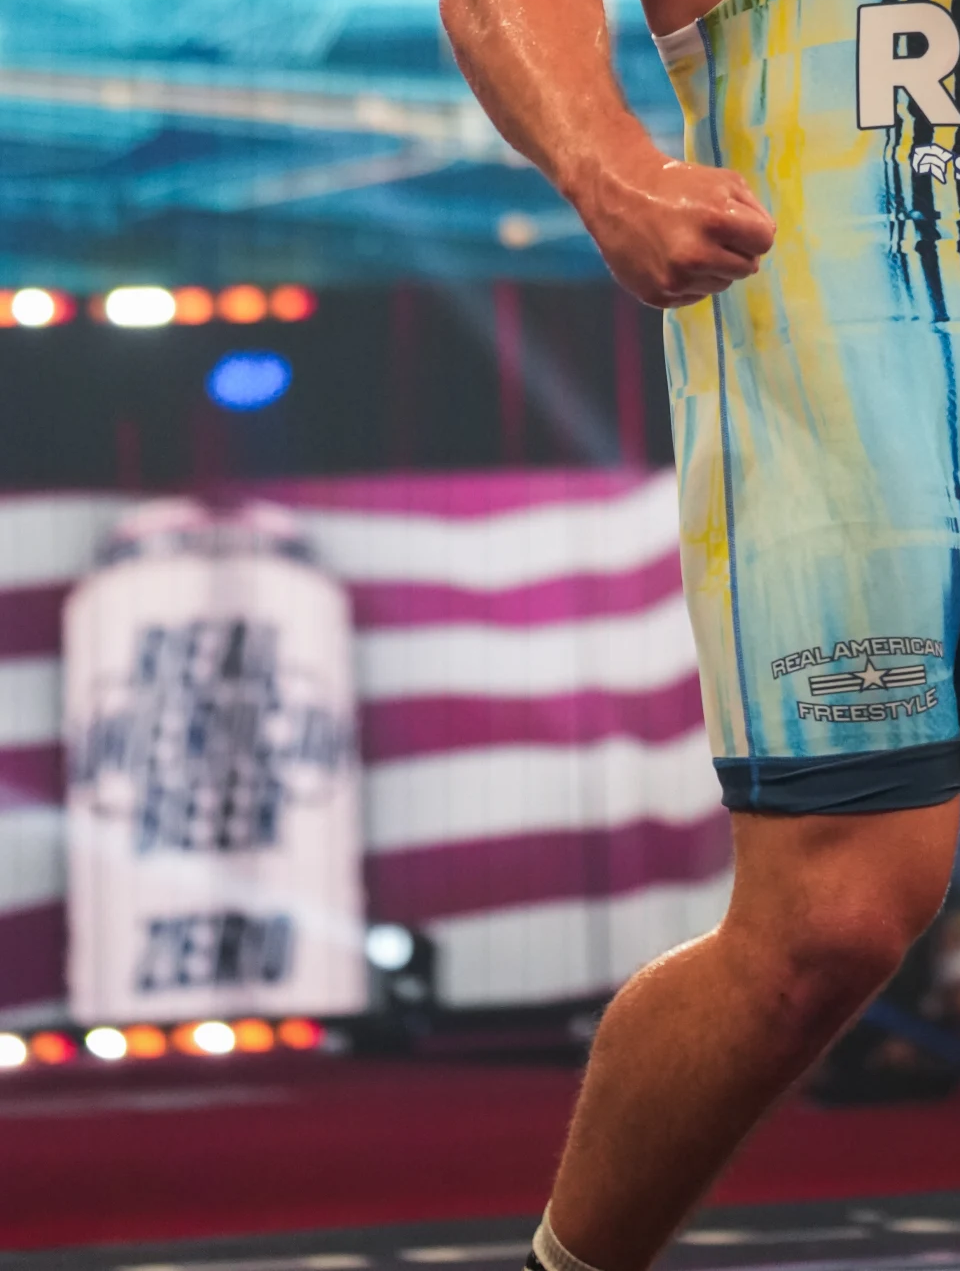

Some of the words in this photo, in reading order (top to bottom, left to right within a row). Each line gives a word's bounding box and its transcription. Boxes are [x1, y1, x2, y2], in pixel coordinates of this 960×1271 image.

[771, 646, 831, 679] REAL
[833, 637, 944, 659] AMERICAN
[797, 687, 939, 723] FREESTYLE
